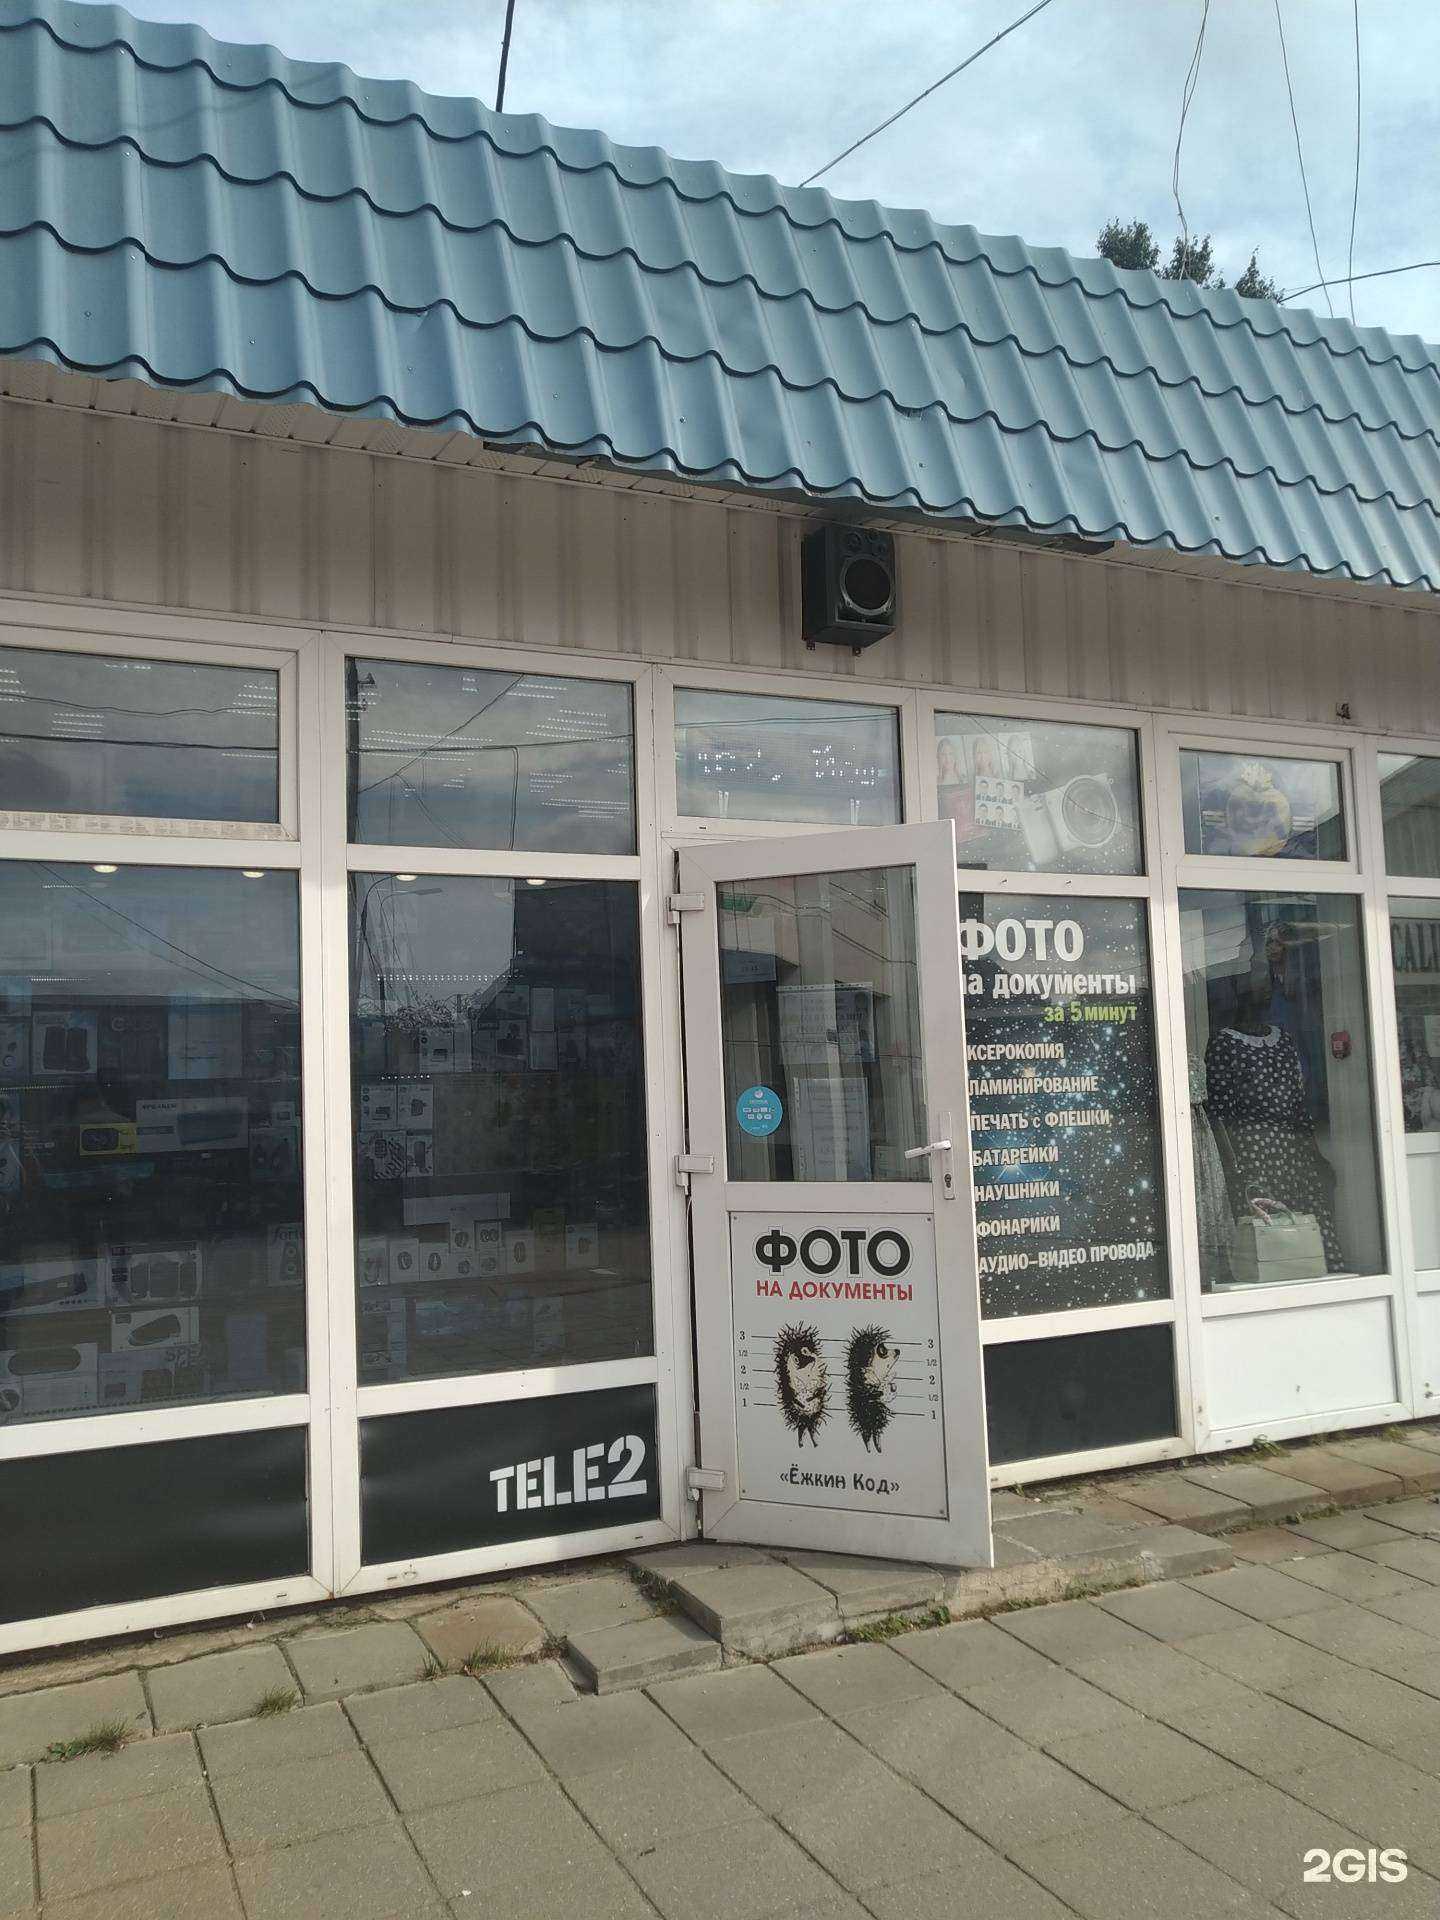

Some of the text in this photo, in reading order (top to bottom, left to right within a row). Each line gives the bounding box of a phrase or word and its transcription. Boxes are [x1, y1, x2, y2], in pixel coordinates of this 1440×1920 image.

[959, 918, 1085, 962] ФОТО
[992, 973, 1136, 1000] документы
[1043, 1001, 1138, 1025] за 5 минут
[966, 1043, 1065, 1061] КСЕРОКОПИЯ
[968, 1076, 1100, 1096] ЛАМИНИРОВАНИЕ
[970, 1112, 1029, 1131] ПЕЧАТЬ
[1044, 1109, 1111, 1128] ФЛЕШКИ
[972, 1143, 1059, 1168] БАТАРЕЙКИ
[974, 1180, 1061, 1203] НАУШНИКИ
[976, 1214, 1061, 1239] ФОНАРИКИ
[754, 1228, 912, 1277] ФОТО
[1090, 1241, 1155, 1263] ПРОВОДА
[756, 1280, 913, 1302] НА ДОКУМЕНТЫ
[739, 1330, 746, 1341] 3
[928, 1339, 935, 1349] 3
[740, 1366, 747, 1375] 2
[929, 1375, 936, 1385] 2
[742, 1398, 748, 1408] 1
[931, 1410, 937, 1420] 1
[489, 1434, 648, 1513] TELE2
